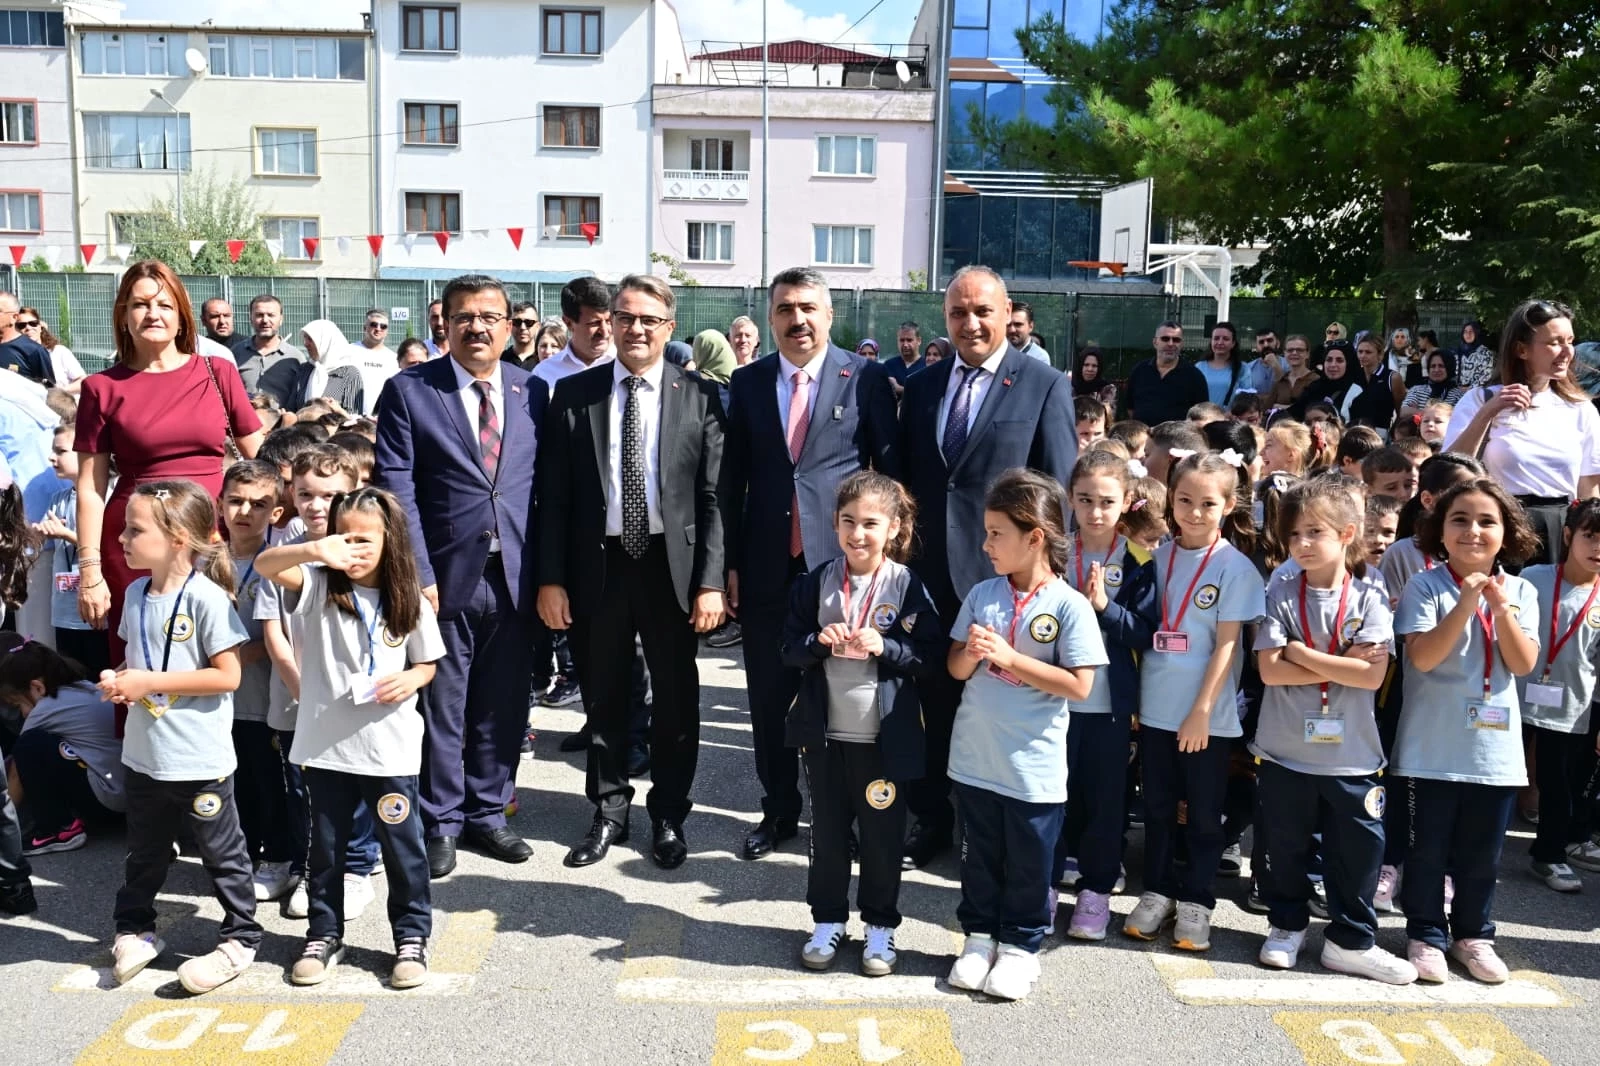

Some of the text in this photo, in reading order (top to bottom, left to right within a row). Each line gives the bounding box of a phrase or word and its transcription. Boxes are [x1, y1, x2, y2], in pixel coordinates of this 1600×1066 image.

[123, 1007, 297, 1052] 1-D
[744, 1018, 906, 1063] 1-C
[1320, 1019, 1496, 1066] 1-B
